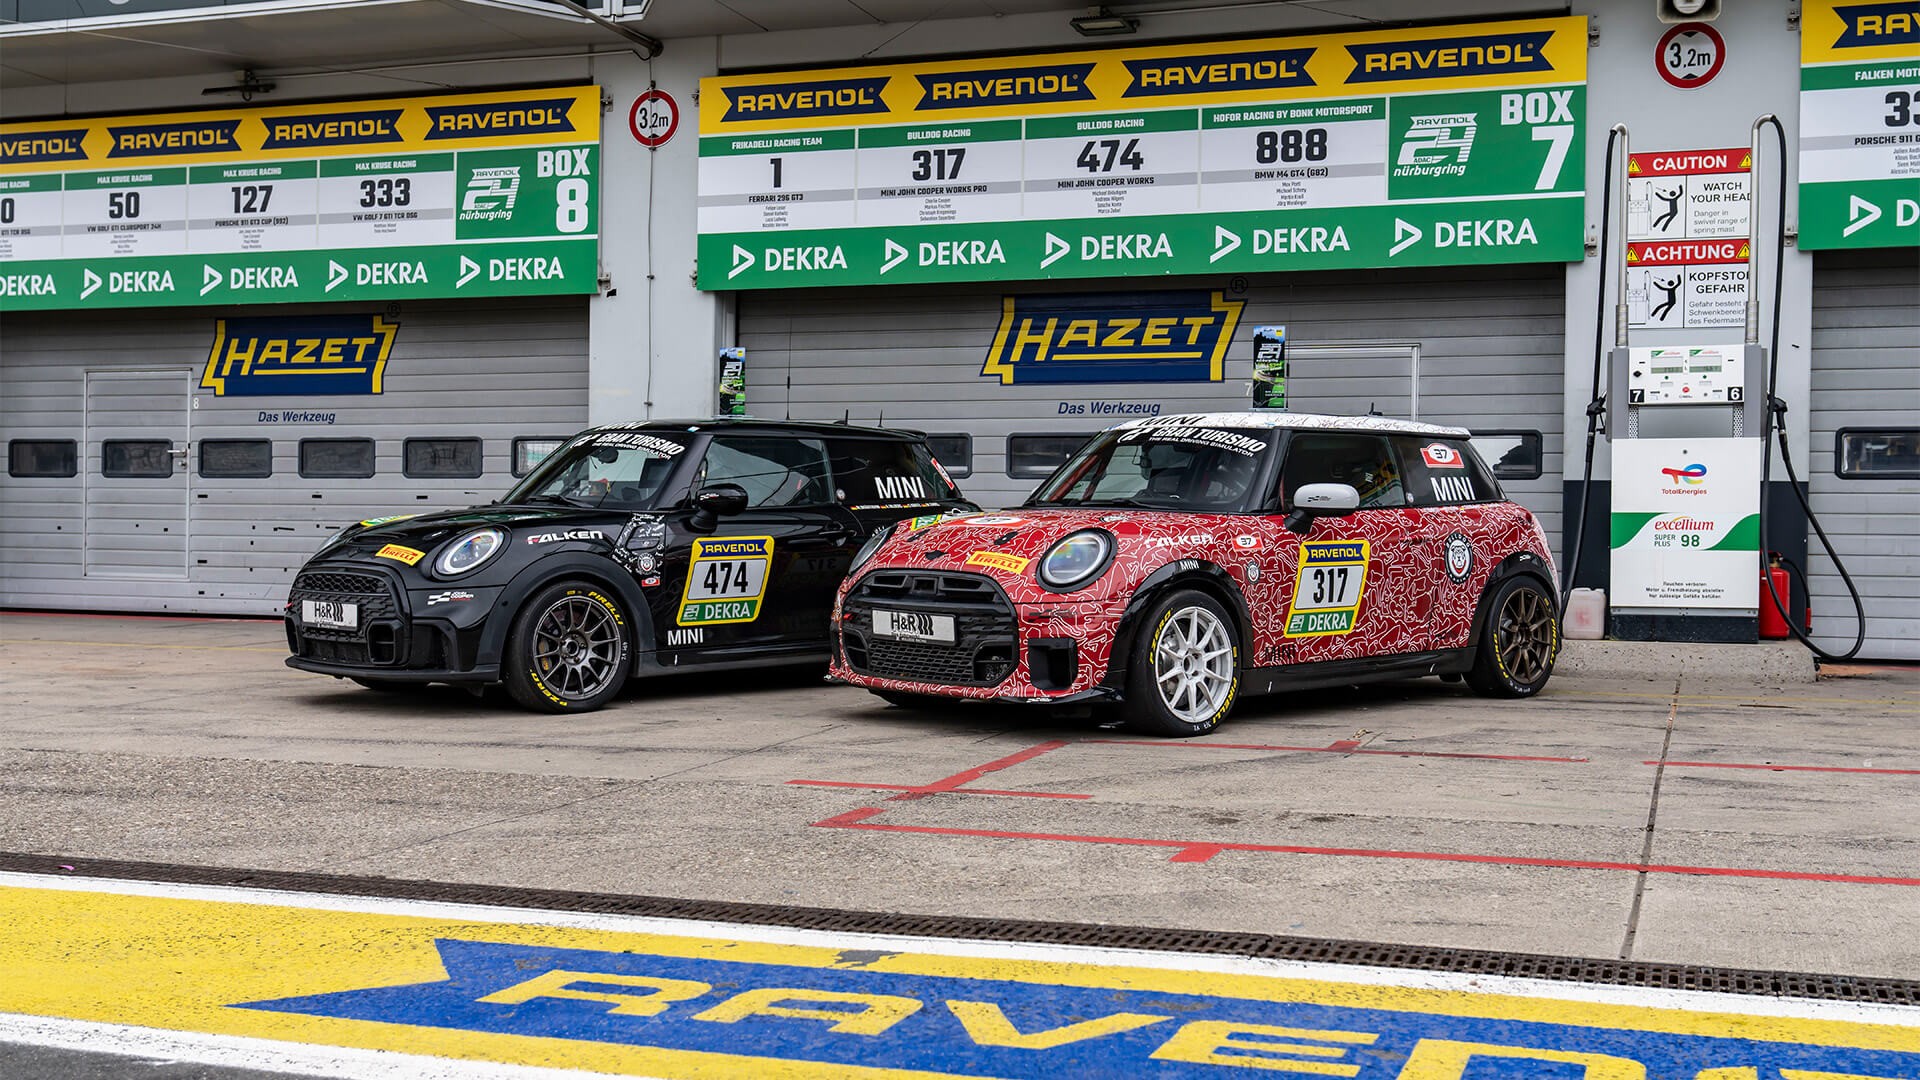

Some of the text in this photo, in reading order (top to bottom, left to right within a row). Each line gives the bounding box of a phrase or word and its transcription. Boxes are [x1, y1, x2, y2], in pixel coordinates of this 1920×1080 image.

[1366, 43, 1533, 73] RAVENOL
[1141, 60, 1297, 87] RAVENOL
[1855, 68, 1920, 81] FALKEN MOT
[933, 75, 1079, 101] RAVENOL
[738, 88, 875, 112] RAVENOL
[1501, 90, 1574, 125] BOX
[1885, 91, 1920, 127] 3
[439, 108, 561, 132] RAVENOL
[1077, 119, 1144, 130] BULLDOG RACING
[1213, 105, 1373, 122] HOFOR RACING BY BONK MOTORSPORT
[1416, 117, 1471, 126] RAVENOL
[120, 129, 229, 151] RAVENOL
[275, 119, 390, 141] RAVENOL
[907, 129, 971, 140] BULLDOG RACING
[1855, 135, 1913, 145] PORSCHE 911
[0, 138, 77, 157] VENOL
[773, 138, 801, 147] RACING
[802, 137, 822, 146] TEAM
[1256, 128, 1327, 164] 888
[537, 148, 590, 177] BOX
[912, 148, 966, 181] 317
[1077, 138, 1144, 173] 474
[1531, 124, 1574, 191] 7
[1652, 156, 1727, 171] CAUTION
[770, 158, 782, 188] 1
[1254, 171, 1275, 179] BMW
[1276, 170, 1289, 178] M4
[1290, 169, 1305, 177] GT4
[1393, 164, 1467, 177] nürburgring
[359, 178, 411, 208] 333
[881, 189, 896, 197] MINI
[897, 187, 916, 196] JOHN
[917, 187, 944, 195] COOPER
[945, 186, 972, 194] WORKS
[1057, 176, 1154, 188] MINI JOHN COOPER WORKS
[1703, 182, 1742, 191] WATCH
[109, 191, 140, 219] 50
[231, 185, 273, 214] 127
[556, 178, 589, 233] 8
[748, 195, 776, 203] FERRARI
[1691, 194, 1721, 203] YOUR
[459, 210, 513, 221] nürburgring
[1717, 218, 1739, 226] range
[1253, 225, 1351, 254] DEKRA
[1435, 217, 1538, 248] DEKRA
[765, 245, 848, 271] DEKRA
[919, 239, 1006, 266] DEKRA
[1081, 233, 1174, 261] DEKRA
[1642, 244, 1735, 261] ACHTUNG
[230, 265, 299, 289] DEKRA
[357, 261, 428, 286] DEKRA
[489, 256, 564, 281] DEKRA
[1689, 271, 1749, 282] KOPFSTO
[109, 269, 175, 293] DEKRA
[1696, 283, 1745, 294] GEFAHR
[1010, 316, 1215, 362] HAZET
[221, 337, 377, 376] HAZET
[193, 397, 200, 409] 8
[1633, 387, 1740, 402] 7 6
[257, 411, 336, 425] Das Werkzeug
[1057, 402, 1161, 416] Das Werkzeug
[626, 433, 685, 455] TURISMO
[1152, 427, 1267, 453] GRAN TURISMO
[874, 476, 926, 499] MINI
[1430, 476, 1476, 502] MINI
[1662, 488, 1707, 496] TotalEnergies
[1654, 518, 1714, 531] excellium
[527, 530, 604, 545] FALKEN
[705, 543, 763, 553] RAVENOL
[1680, 534, 1700, 547] 98
[381, 546, 418, 561] PIRELLI
[1311, 548, 1360, 559] RAVENOL
[704, 561, 748, 594] 474
[1313, 567, 1348, 604] 317
[588, 591, 624, 625] PIRELLI
[704, 602, 751, 620] DEKRA
[891, 612, 917, 632] H&R
[1308, 612, 1348, 632] DEKRA
[667, 628, 704, 646] MINI
